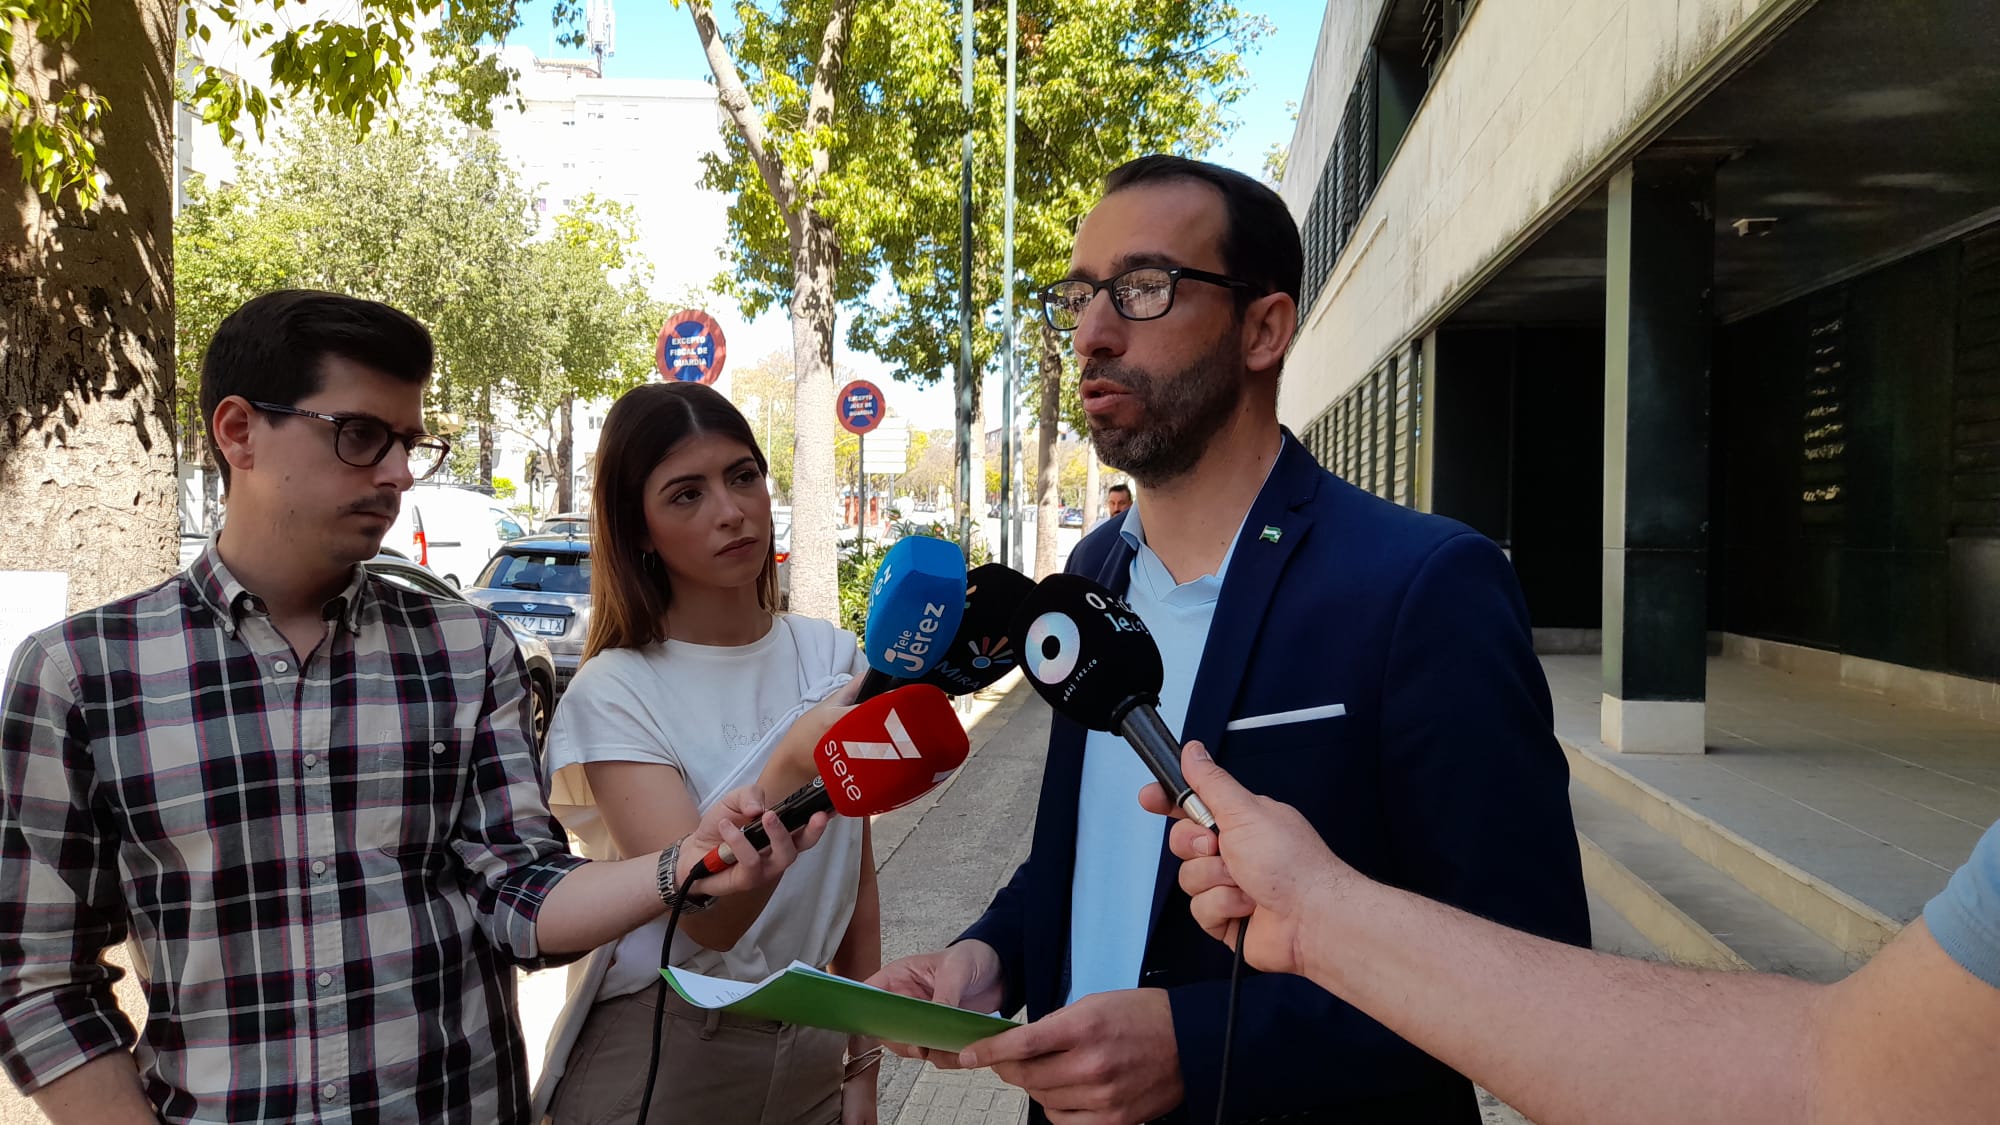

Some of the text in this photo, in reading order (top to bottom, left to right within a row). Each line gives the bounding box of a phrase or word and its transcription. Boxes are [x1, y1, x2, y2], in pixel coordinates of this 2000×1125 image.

[671, 335, 706, 345] EXCEPTO
[670, 346, 708, 356] FISCAL DE
[673, 358, 707, 368] GUARDIA
[539, 618, 562, 631] LTX
[884, 602, 945, 672] Jerez
[893, 630, 912, 650] Tele
